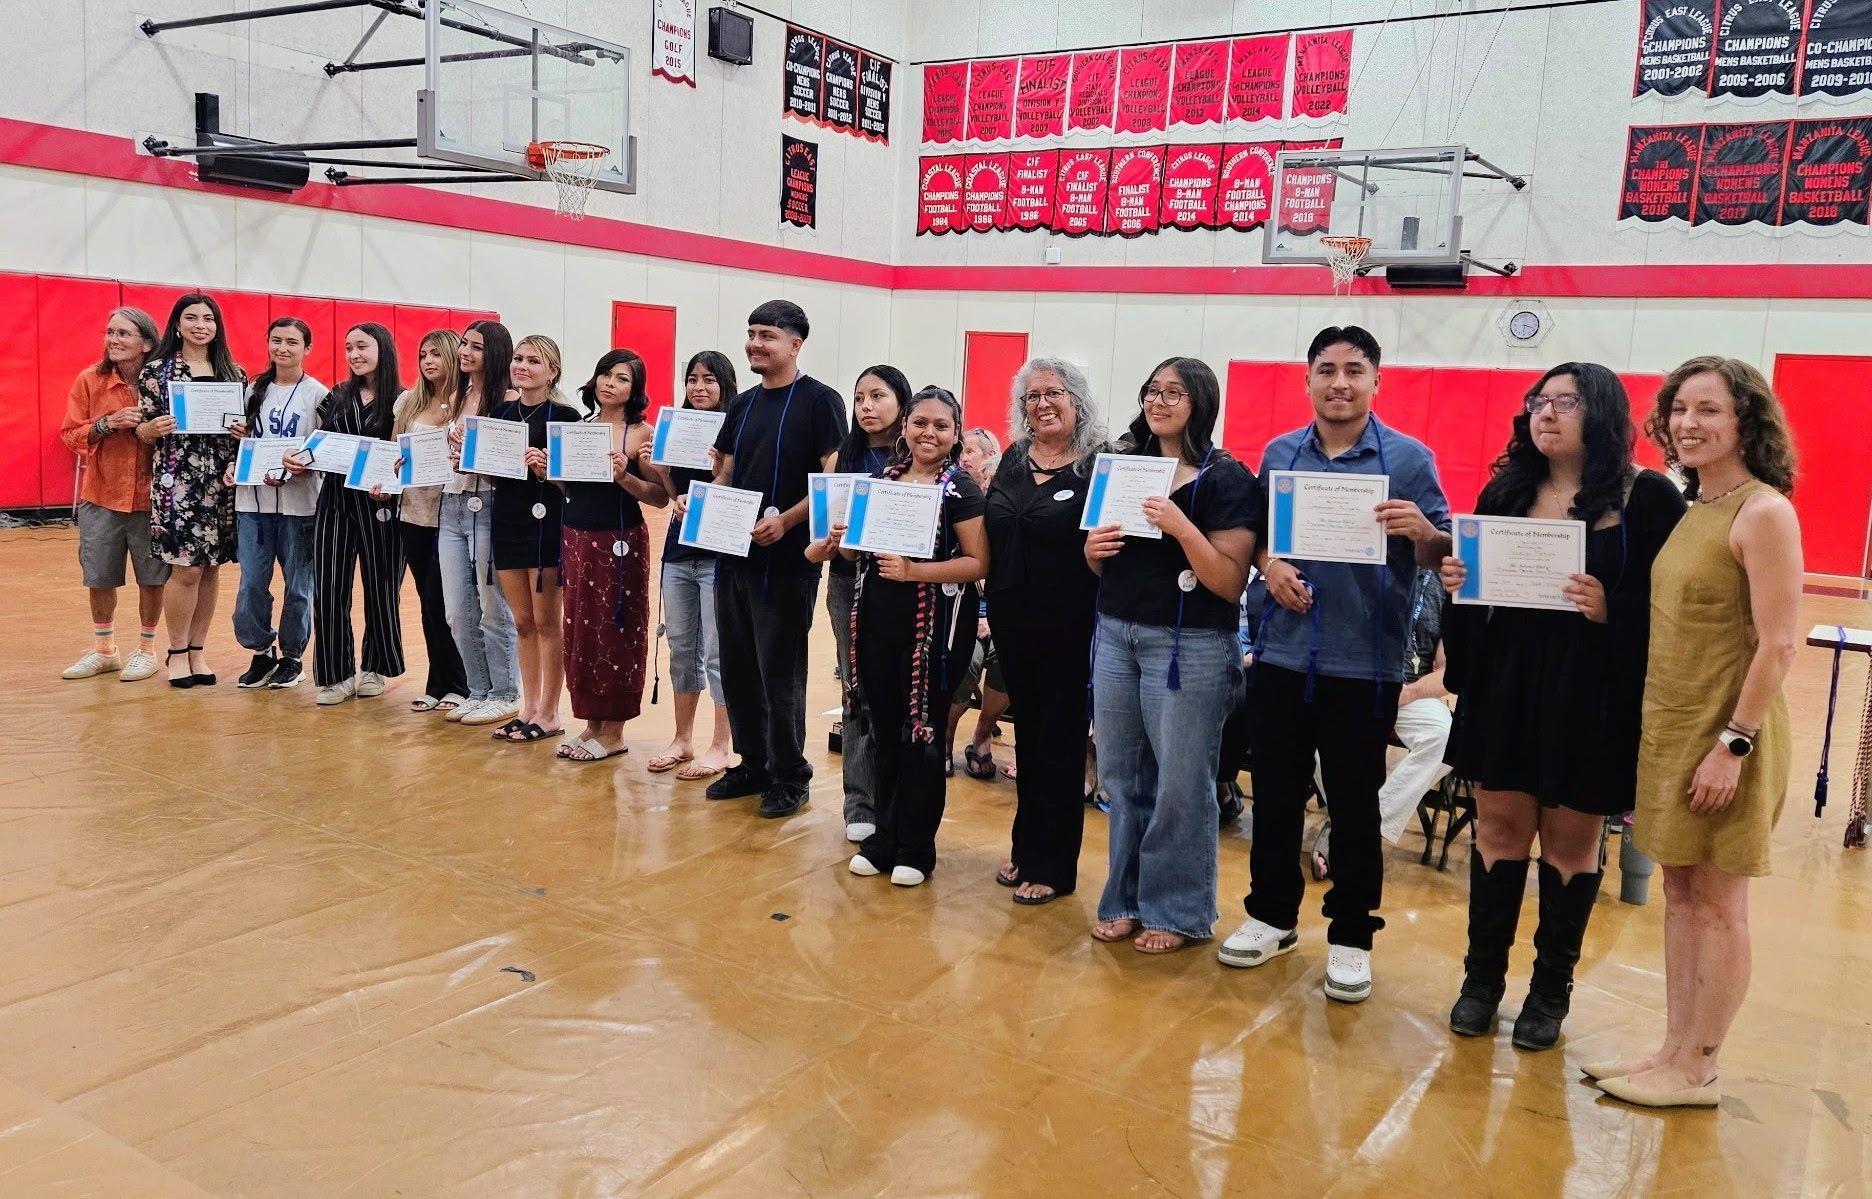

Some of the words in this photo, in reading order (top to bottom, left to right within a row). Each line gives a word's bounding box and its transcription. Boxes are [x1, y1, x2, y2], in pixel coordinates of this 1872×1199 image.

[1644, 16, 1664, 41] CITRUS
[1665, 6, 1689, 19] EAST
[1689, 7, 1712, 35] LEAGUE
[1720, 3, 1743, 36] CITRUS
[1777, 0, 1801, 31] LEAGUE
[657, 19, 691, 40] CHAMPIONS
[665, 40, 683, 54] GOLF
[1725, 36, 1790, 52] CHAMPIONS
[1331, 39, 1349, 63] LEAGUE
[665, 56, 682, 69] 2015
[1640, 54, 1662, 66] MENS
[1662, 51, 1711, 65] BASKETBALL
[1715, 56, 1739, 67] MENS
[1740, 53, 1796, 66] BASKETBALL
[1805, 58, 1830, 69] MENS
[1831, 56, 1872, 68] BASKETB
[869, 58, 881, 72] CIF
[1036, 59, 1057, 73] CIF
[1088, 73, 1099, 83] CIF
[1185, 69, 1215, 80] LEAGUE
[1242, 68, 1273, 78] LEAGUE
[1299, 70, 1346, 83] CHAMPIONS
[1644, 65, 1703, 81] 2001-2002
[796, 75, 810, 88] MENS
[826, 72, 854, 91] CHAMPIONS
[1130, 77, 1159, 88] LEAGUE
[1719, 73, 1786, 87] 2005-2006
[1811, 72, 1872, 88] 2009-201
[793, 85, 814, 100] SOCCER
[832, 86, 847, 99] MENS
[1020, 78, 1068, 95] FINALIST
[1085, 83, 1102, 91] STATE
[1296, 82, 1347, 95] VOLLEYBALL
[978, 89, 1005, 99] LEAGUE
[1124, 90, 1162, 99] CHAMPIONS
[1232, 92, 1279, 103] VOLLEYBALL
[829, 96, 850, 111] SOCCER
[866, 97, 880, 110] MENS
[974, 101, 1007, 111] CHAMPIONS
[1023, 98, 1050, 108] DIVISION
[1122, 104, 1167, 114] VOLLEYBALL
[1308, 99, 1332, 111] 2022
[864, 107, 882, 121] SOCCER
[1019, 111, 1063, 122] VOLLEYBALL
[1070, 106, 1112, 117] VOLLEYBALL
[1242, 106, 1261, 117] 2014
[970, 113, 1009, 123] VOLLEYBALL
[1082, 117, 1100, 127] 2007
[980, 127, 997, 135] 2007
[1031, 124, 1049, 133] 2007
[1629, 132, 1674, 163] MANZANITA
[1675, 132, 1698, 161] LEAGUE
[1792, 126, 1845, 160] MANZANITA
[1846, 127, 1872, 158] LEAGUE
[1026, 156, 1040, 167] CIF
[1171, 151, 1193, 170] CITRUS
[1193, 152, 1216, 170] LEAGUE
[1222, 150, 1249, 179] SOUTHERN
[1249, 146, 1275, 176] CONFERENCE
[1655, 160, 1669, 169] TRI
[1059, 157, 1075, 181] CITRUS
[1075, 153, 1092, 162] EAST
[1093, 155, 1108, 183] LEAGUE
[1112, 152, 1135, 184] SOUTHERN
[1137, 150, 1161, 182] CONFERENCE
[1796, 161, 1864, 176] CHAMPIONS
[922, 163, 944, 190] COASTAL
[944, 163, 962, 189] LEAGUE
[965, 160, 988, 190] COASTAL
[989, 160, 1007, 189] LEAGUE
[1017, 169, 1048, 179] FINALIST
[1076, 170, 1089, 181] CIF
[1286, 173, 1332, 185] CHAMPIONS
[1631, 168, 1690, 180] CHAMPIONS
[1066, 182, 1098, 192] FINALIST
[1169, 177, 1212, 188] CHAMPIONS
[1233, 178, 1261, 188] 8-MAN
[1639, 180, 1680, 192] WOMENS
[1804, 176, 1850, 189] WOMENS
[1021, 184, 1044, 195] 8-MAN
[1118, 183, 1151, 195] FINALIST
[1176, 189, 1202, 199] 8-MAN
[1226, 189, 1266, 200] FOOTBALL
[1295, 187, 1320, 197] 8-MAN
[923, 190, 959, 202] CHAMPIONS
[965, 190, 1004, 202] CHAMPIONS
[1012, 197, 1049, 207] FOOTBALL
[1069, 193, 1093, 203] 8-MAN
[1120, 197, 1144, 206] 8-MAN
[1626, 192, 1688, 204] BASKETBALL
[1789, 189, 1865, 204] BASKETBALL
[924, 204, 957, 214] FOOTBALL
[966, 203, 1001, 213] FOOTBALL
[1169, 199, 1208, 210] FOOTBALL
[1224, 199, 1267, 211] CHAMPIONS
[1285, 197, 1325, 209] FOOTBALL
[1062, 204, 1099, 215] FOOTBALL
[1115, 206, 1152, 217] FOOTBALL
[1641, 204, 1670, 216] 2016
[1719, 207, 1747, 219] 2017
[1808, 206, 1838, 218] 2018
[932, 216, 949, 226] 1984
[974, 214, 993, 225] 1986
[1020, 211, 1039, 221] 1986
[1069, 217, 1088, 227] 2005
[1177, 211, 1197, 222] 2014
[1233, 211, 1255, 222] 2014
[1121, 219, 1142, 229] 2006
[1304, 484, 1333, 493] Certificate
[1490, 528, 1524, 538] Certificate
[1525, 530, 1532, 538] of
[1533, 531, 1571, 540] Membership
